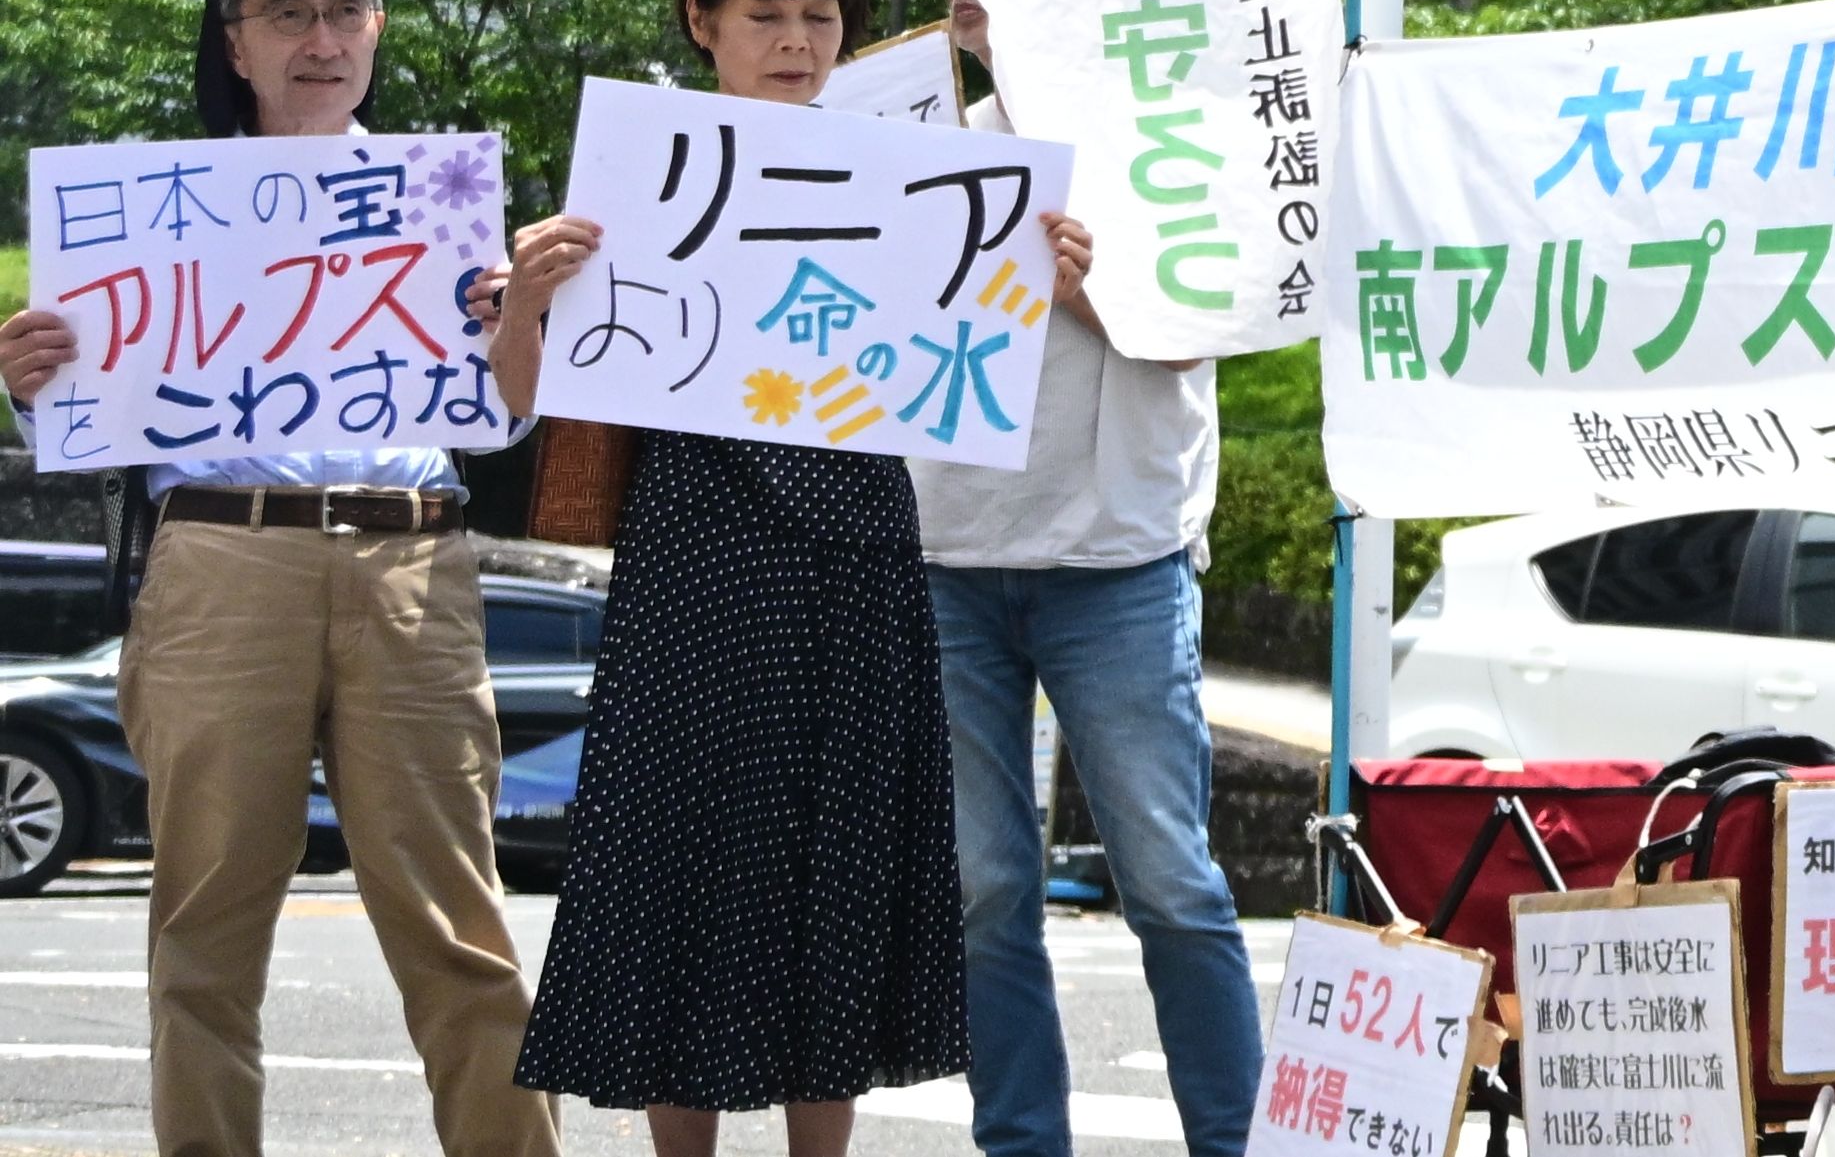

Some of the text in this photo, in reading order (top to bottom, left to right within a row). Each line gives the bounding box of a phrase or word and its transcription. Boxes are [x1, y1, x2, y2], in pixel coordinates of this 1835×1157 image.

[55, 147, 407, 251] 日本の宝
[659, 122, 1032, 311] リニア
[1532, 938, 1715, 976] リニア工事は安全に
[1292, 969, 1459, 1059] 1日52人で
[1536, 996, 1708, 1033] 進めても、完成後水
[1539, 1053, 1725, 1090] は確実に富士川に流
[1267, 1053, 1433, 1157] 納得できない
[1543, 1109, 1692, 1148] れ出る。責任は？
